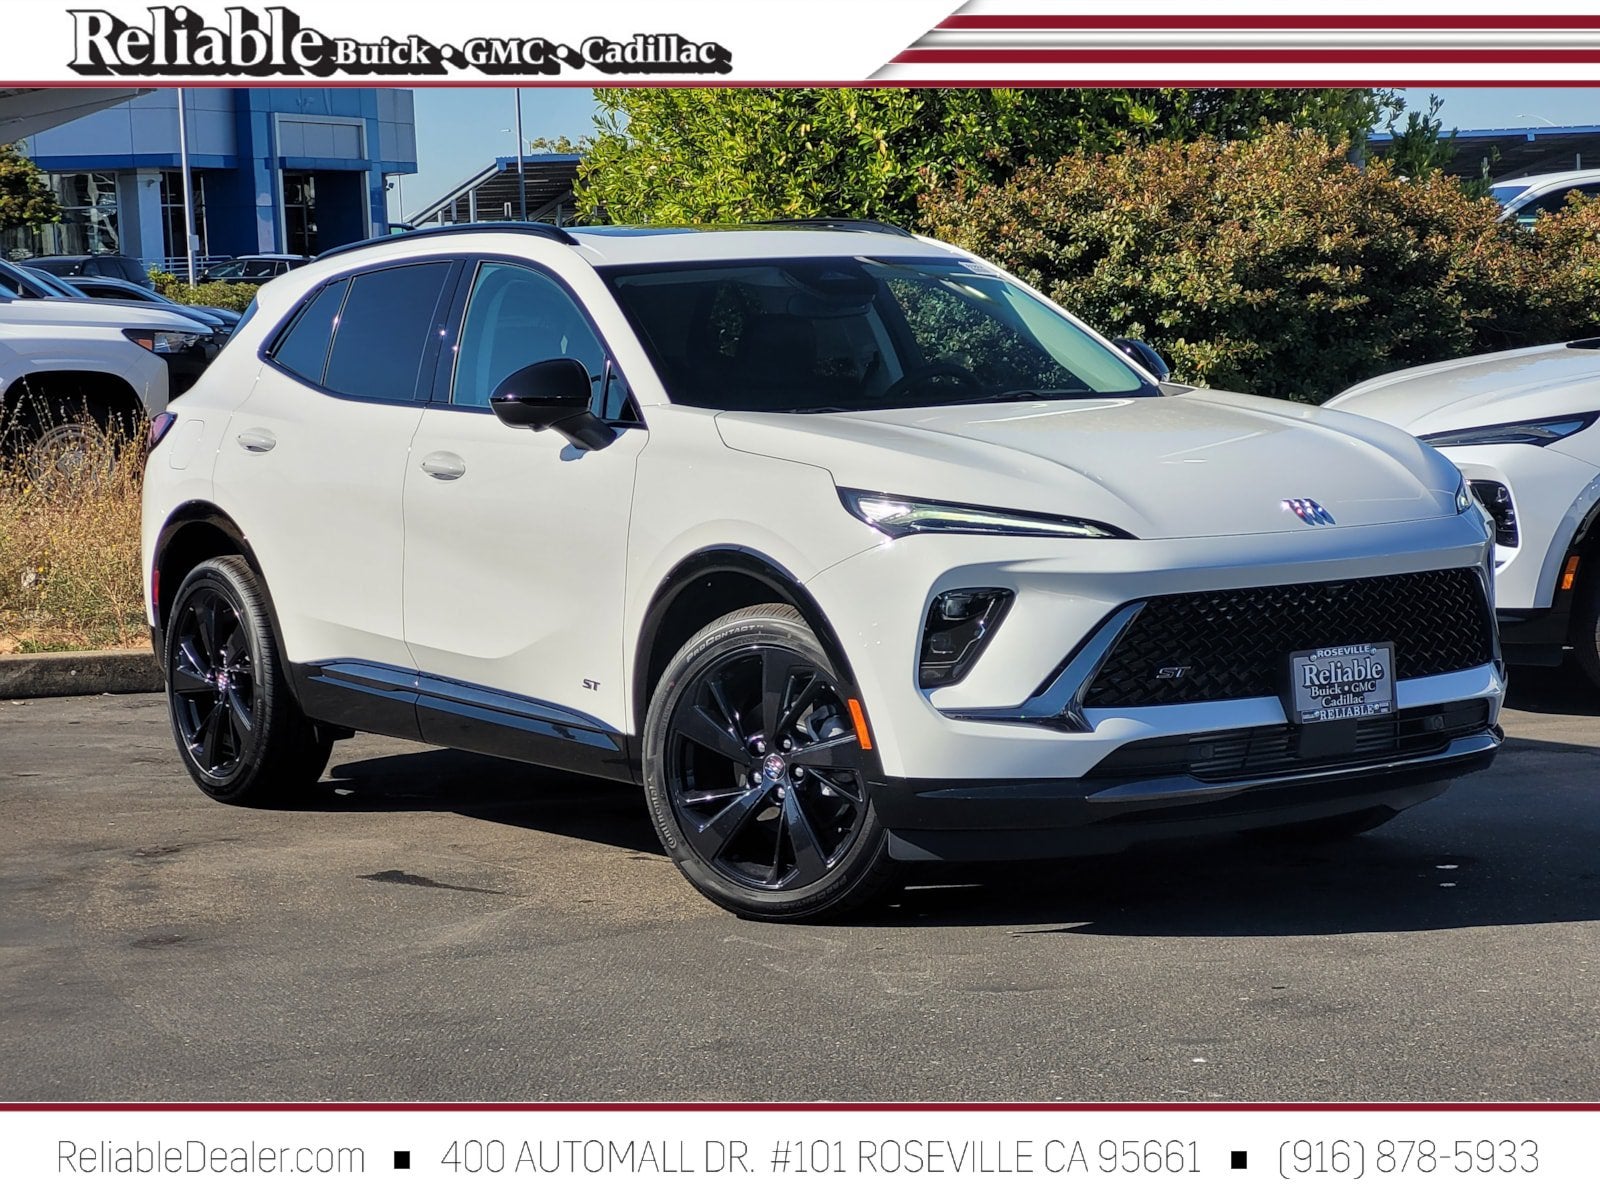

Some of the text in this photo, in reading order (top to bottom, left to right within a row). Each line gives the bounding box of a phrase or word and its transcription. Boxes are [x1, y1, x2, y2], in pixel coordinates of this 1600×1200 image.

[1316, 645, 1371, 658] ROSEVILLE
[1156, 666, 1191, 679] ST
[1302, 657, 1384, 687] Reliable
[582, 678, 600, 691] ST
[1311, 681, 1376, 697] Buick GMC
[1321, 694, 1364, 707] Cadillac
[1319, 704, 1375, 721] RELIABLE
